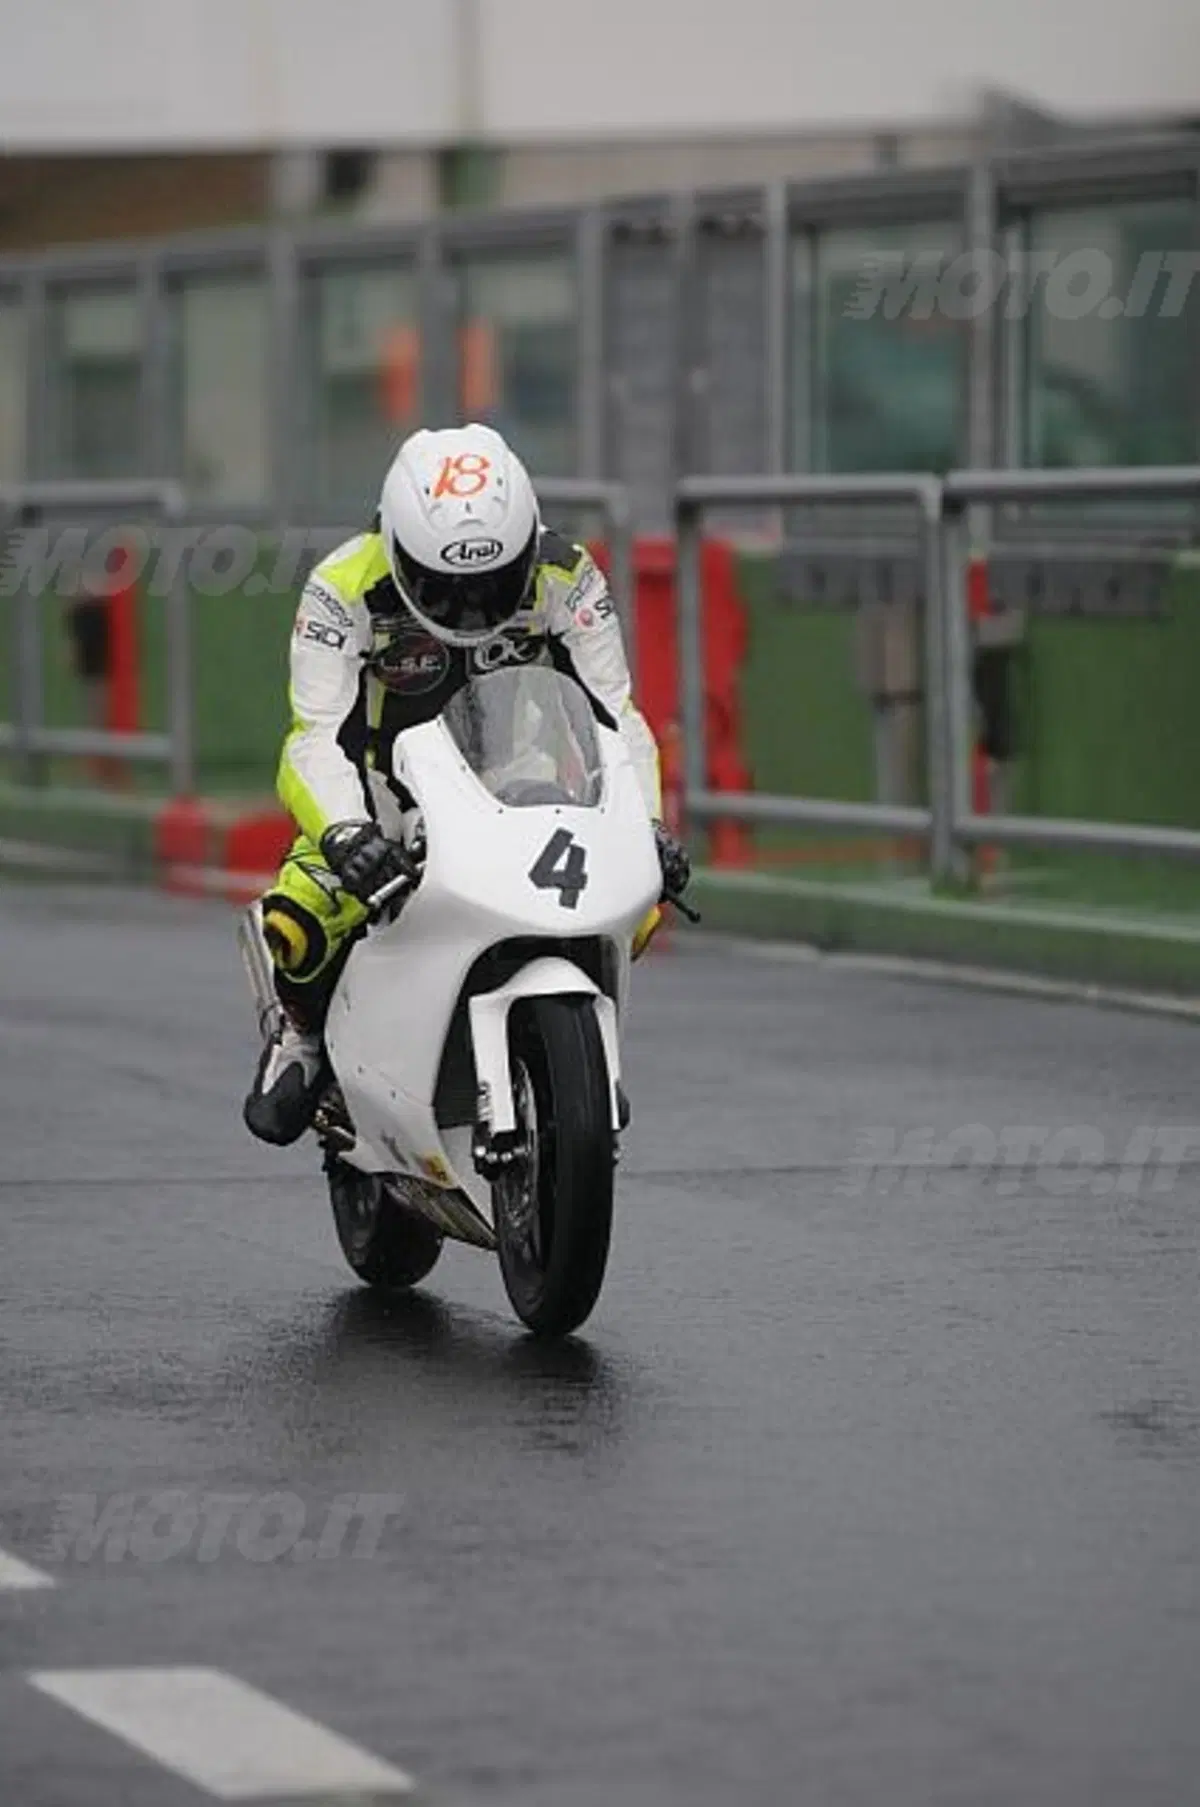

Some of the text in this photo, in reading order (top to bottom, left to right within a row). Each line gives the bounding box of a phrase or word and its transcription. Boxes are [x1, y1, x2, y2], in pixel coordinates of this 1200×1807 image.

[434, 453, 489, 498] 18
[443, 539, 501, 565] Arai
[528, 826, 588, 910] 4
